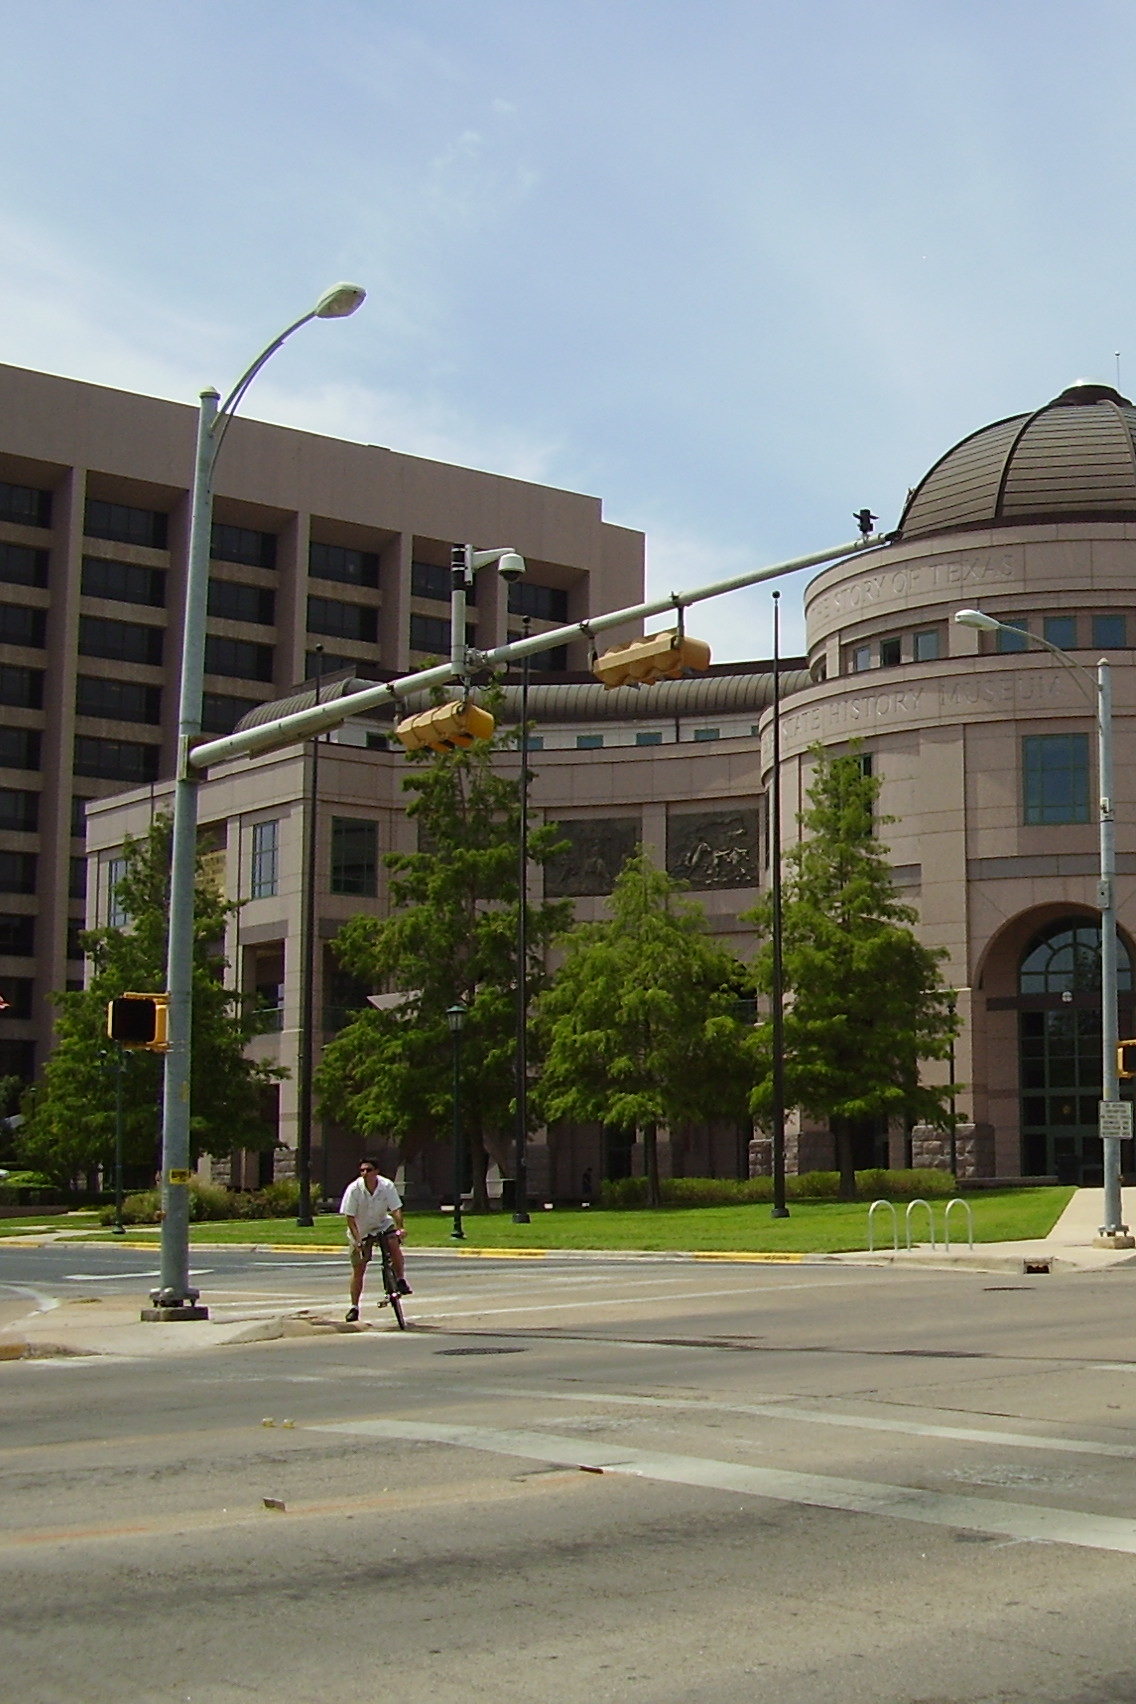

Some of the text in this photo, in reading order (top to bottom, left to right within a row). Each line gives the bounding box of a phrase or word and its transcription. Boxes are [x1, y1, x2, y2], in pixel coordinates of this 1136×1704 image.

[834, 576, 885, 612] STORY
[892, 569, 920, 593] OF
[930, 555, 1014, 585] TEXAS
[782, 708, 820, 740] STATE
[829, 687, 924, 723] HISTORY
[940, 676, 1060, 706] MUSEUM
